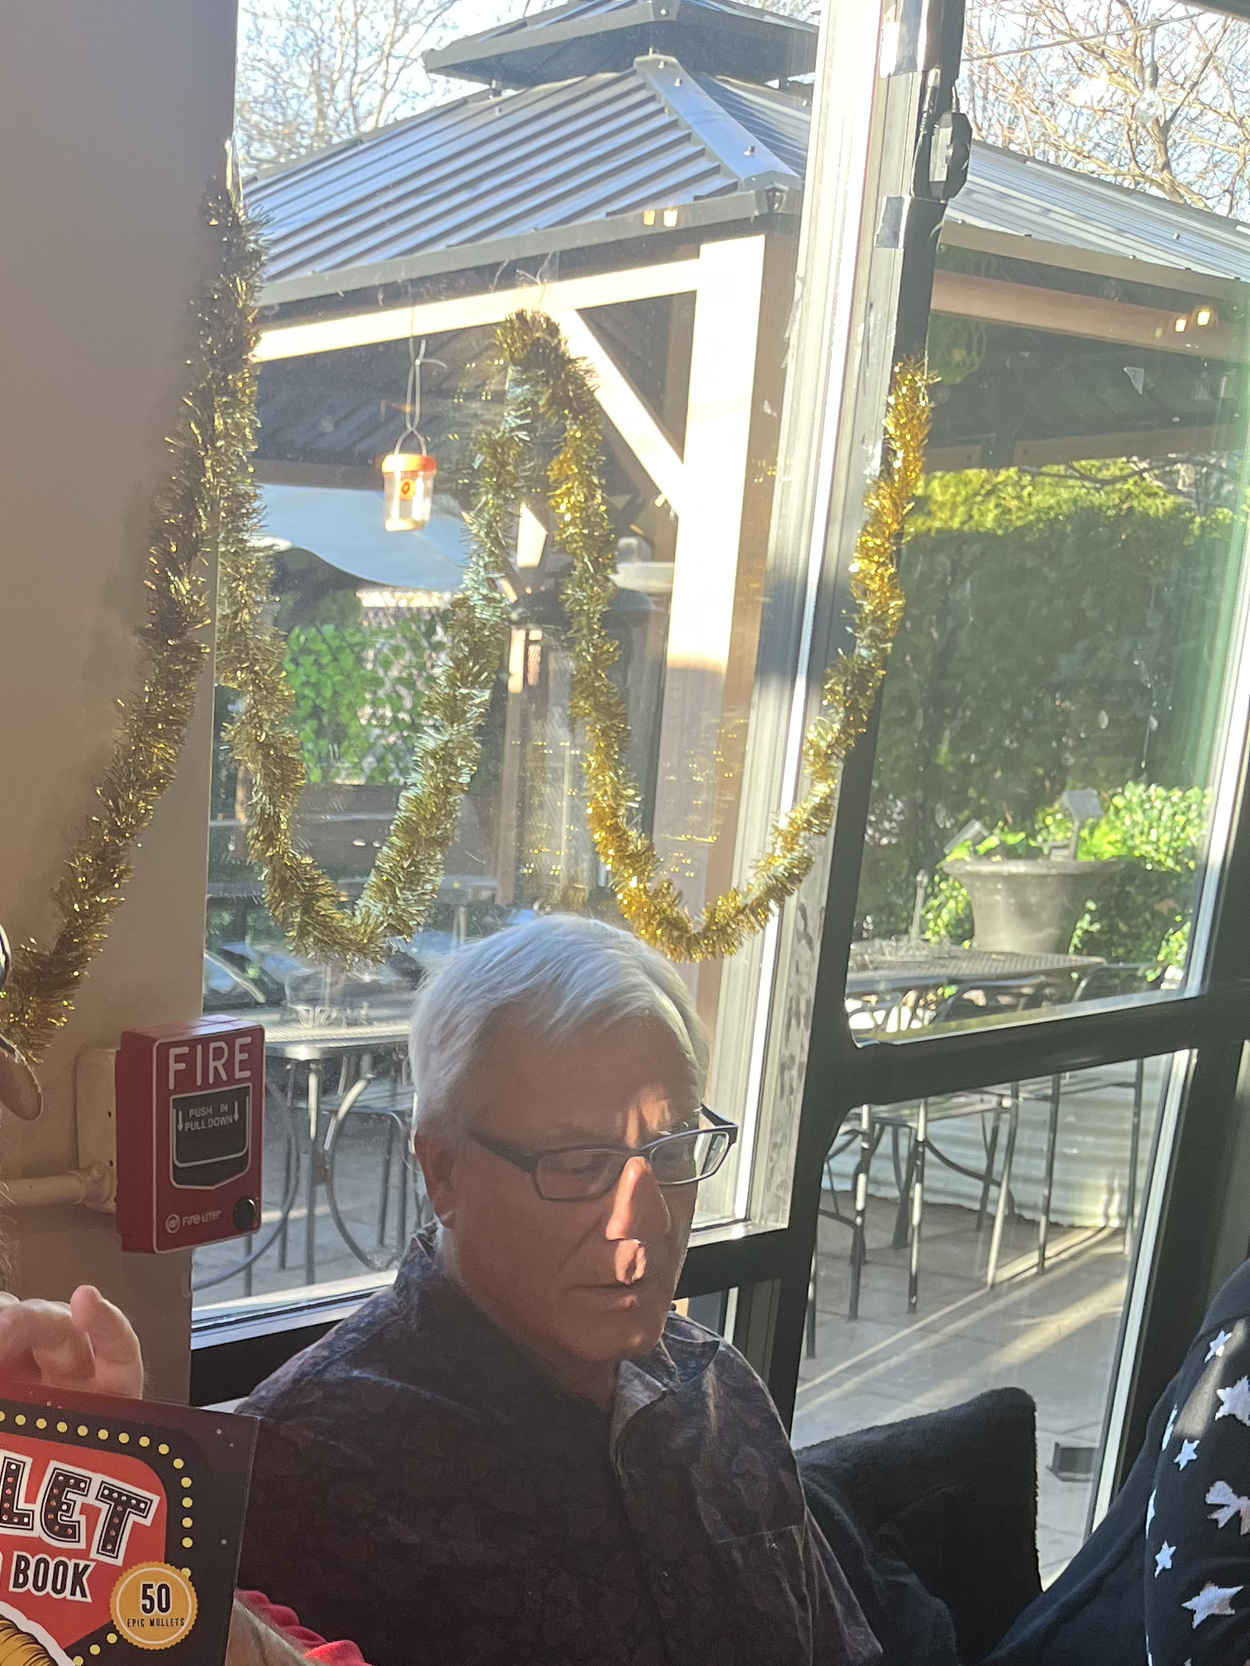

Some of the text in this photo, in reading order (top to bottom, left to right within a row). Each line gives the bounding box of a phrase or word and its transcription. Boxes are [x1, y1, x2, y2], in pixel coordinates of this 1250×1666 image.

[168, 1037, 252, 1090] FIRE
[184, 1115, 234, 1132] PULL DOWN
[188, 1103, 229, 1119] PUSH IN
[10, 1553, 94, 1602] BOOK
[140, 1582, 171, 1616] 50
[127, 1617, 185, 1627] EPIC MULLETS
